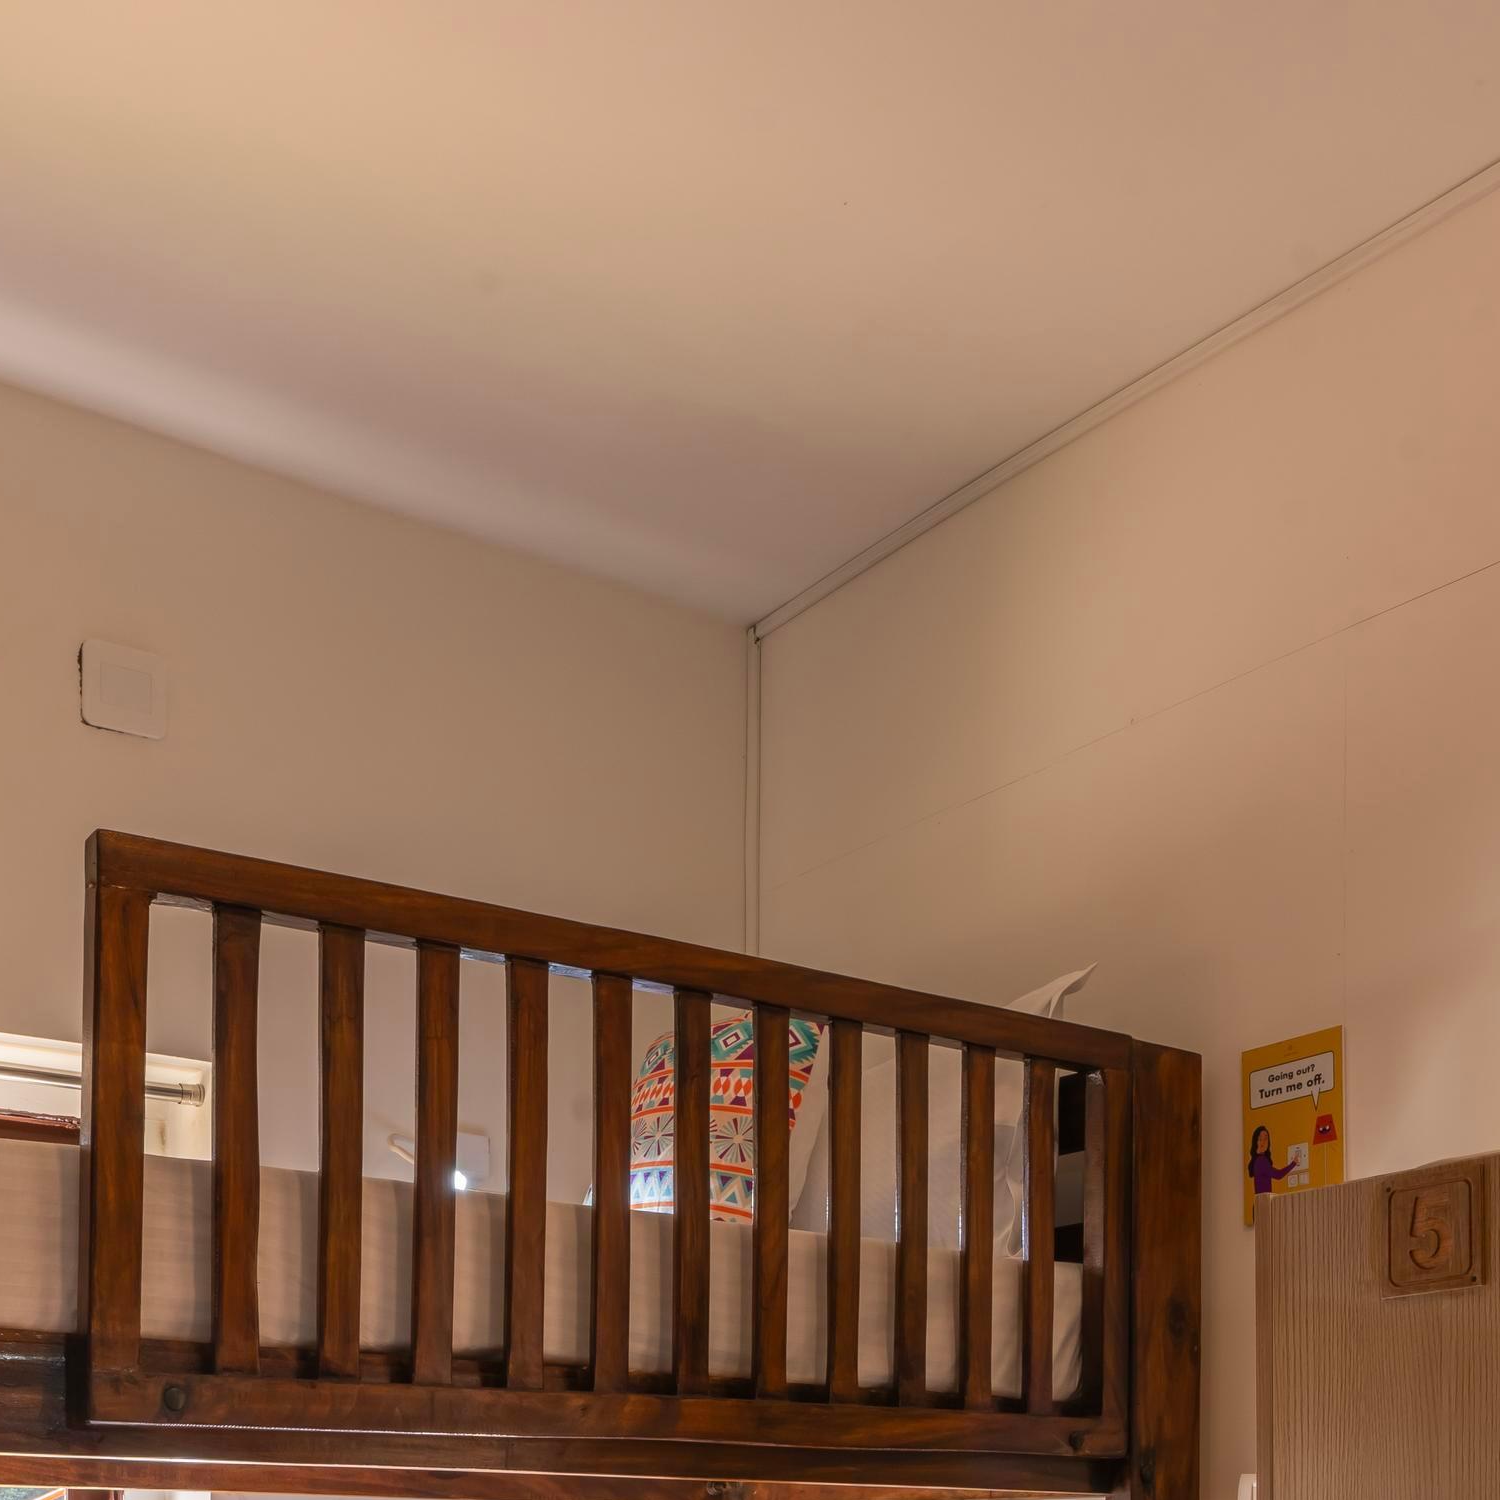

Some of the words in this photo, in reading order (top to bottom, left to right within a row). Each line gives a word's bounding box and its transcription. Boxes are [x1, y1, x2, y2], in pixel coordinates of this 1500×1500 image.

[1259, 1087, 1283, 1099] Turn
[1286, 1083, 1303, 1092] me
[1307, 1073, 1325, 1088] off.
[1268, 1070, 1294, 1083] Going
[1297, 1063, 1315, 1076] out?
[1409, 1195, 1453, 1269] 5
